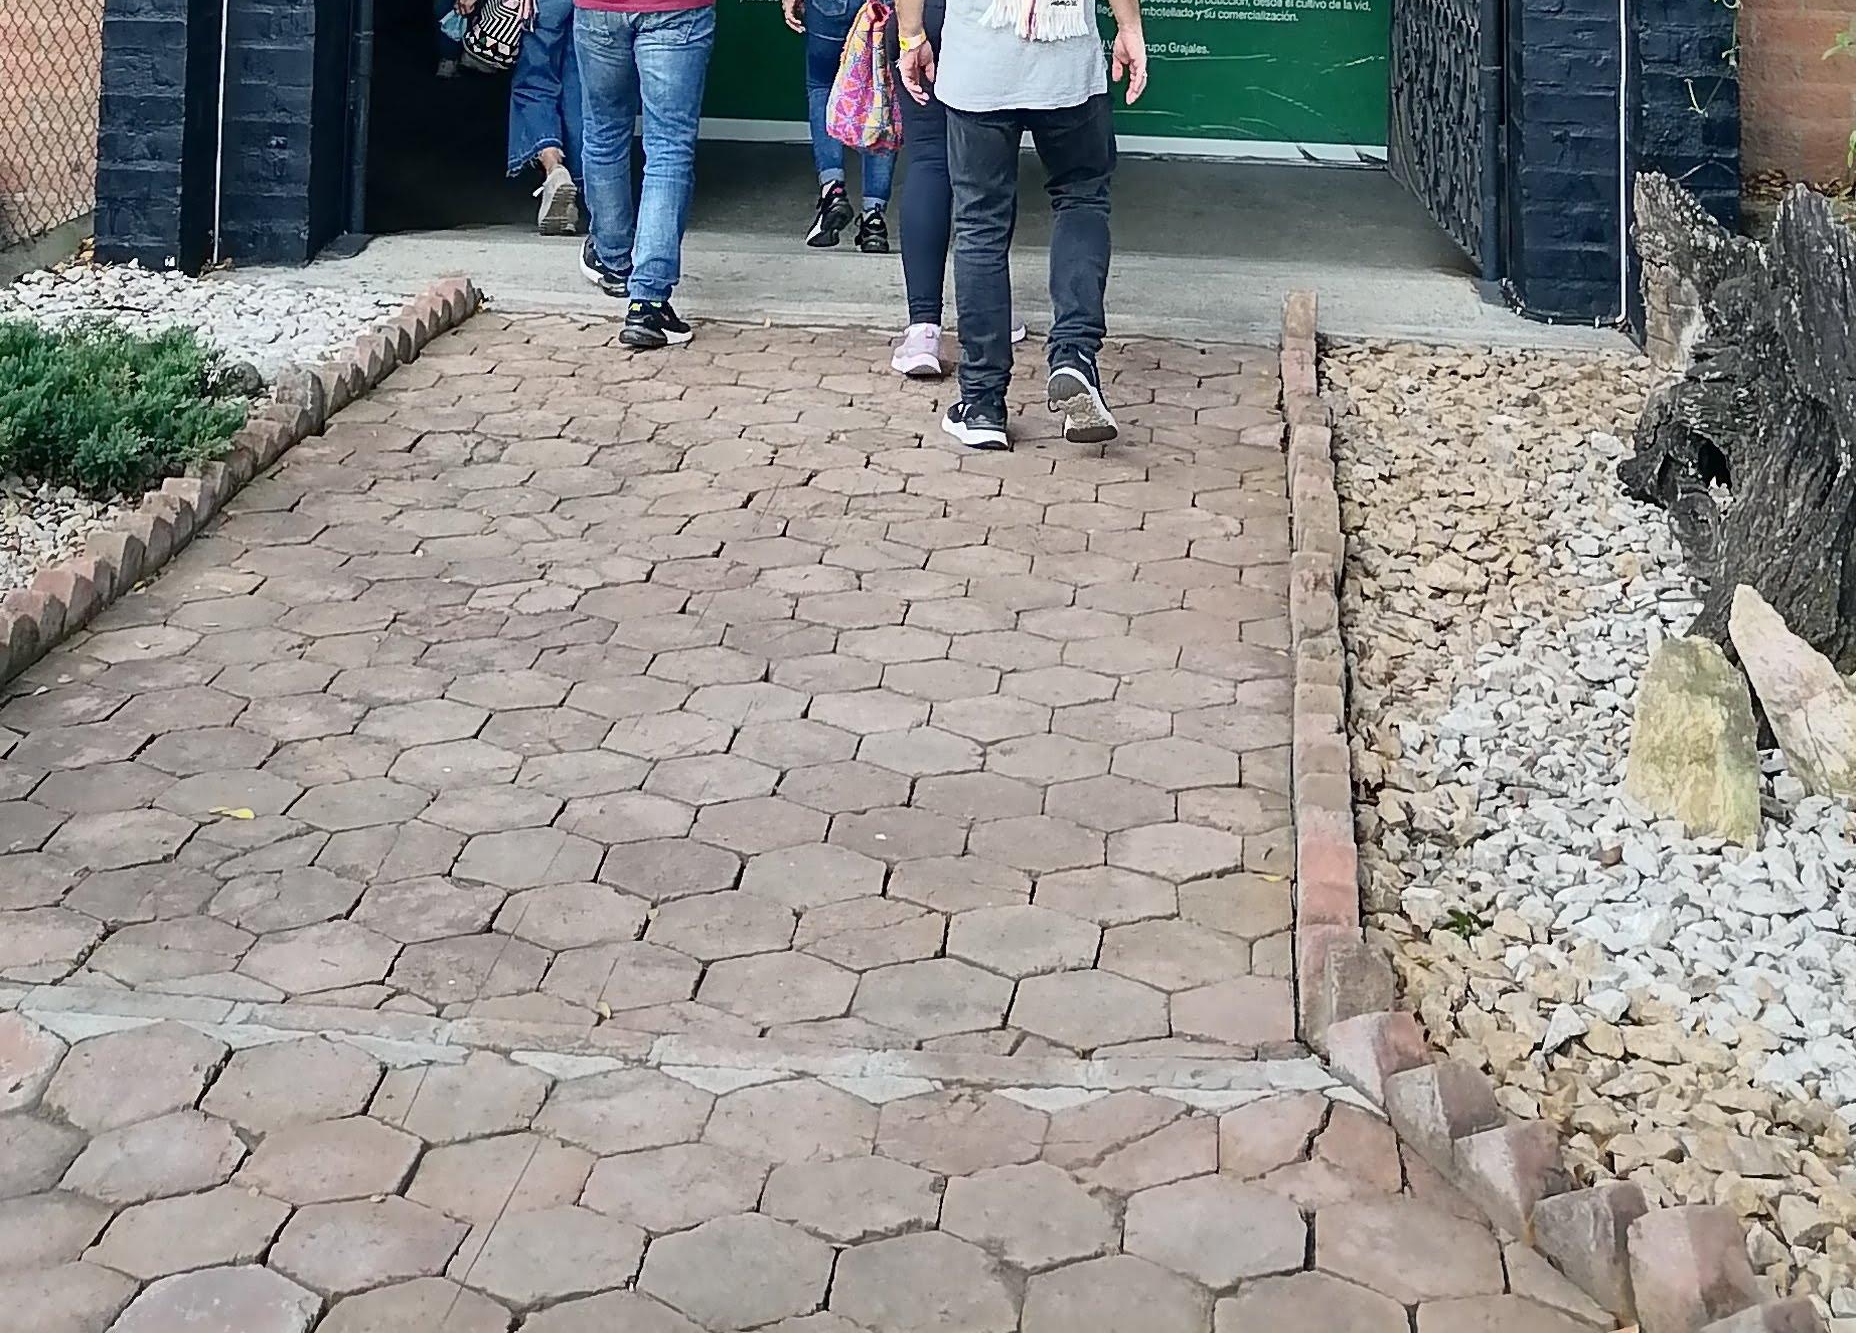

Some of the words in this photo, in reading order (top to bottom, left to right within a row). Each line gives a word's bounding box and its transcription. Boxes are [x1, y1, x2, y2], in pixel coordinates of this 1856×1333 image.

[1328, 0, 1341, 10] de
[1343, 0, 1352, 10] la
[1141, 6, 1193, 17] mbotellado
[1168, 42, 1210, 55] Grajales.
